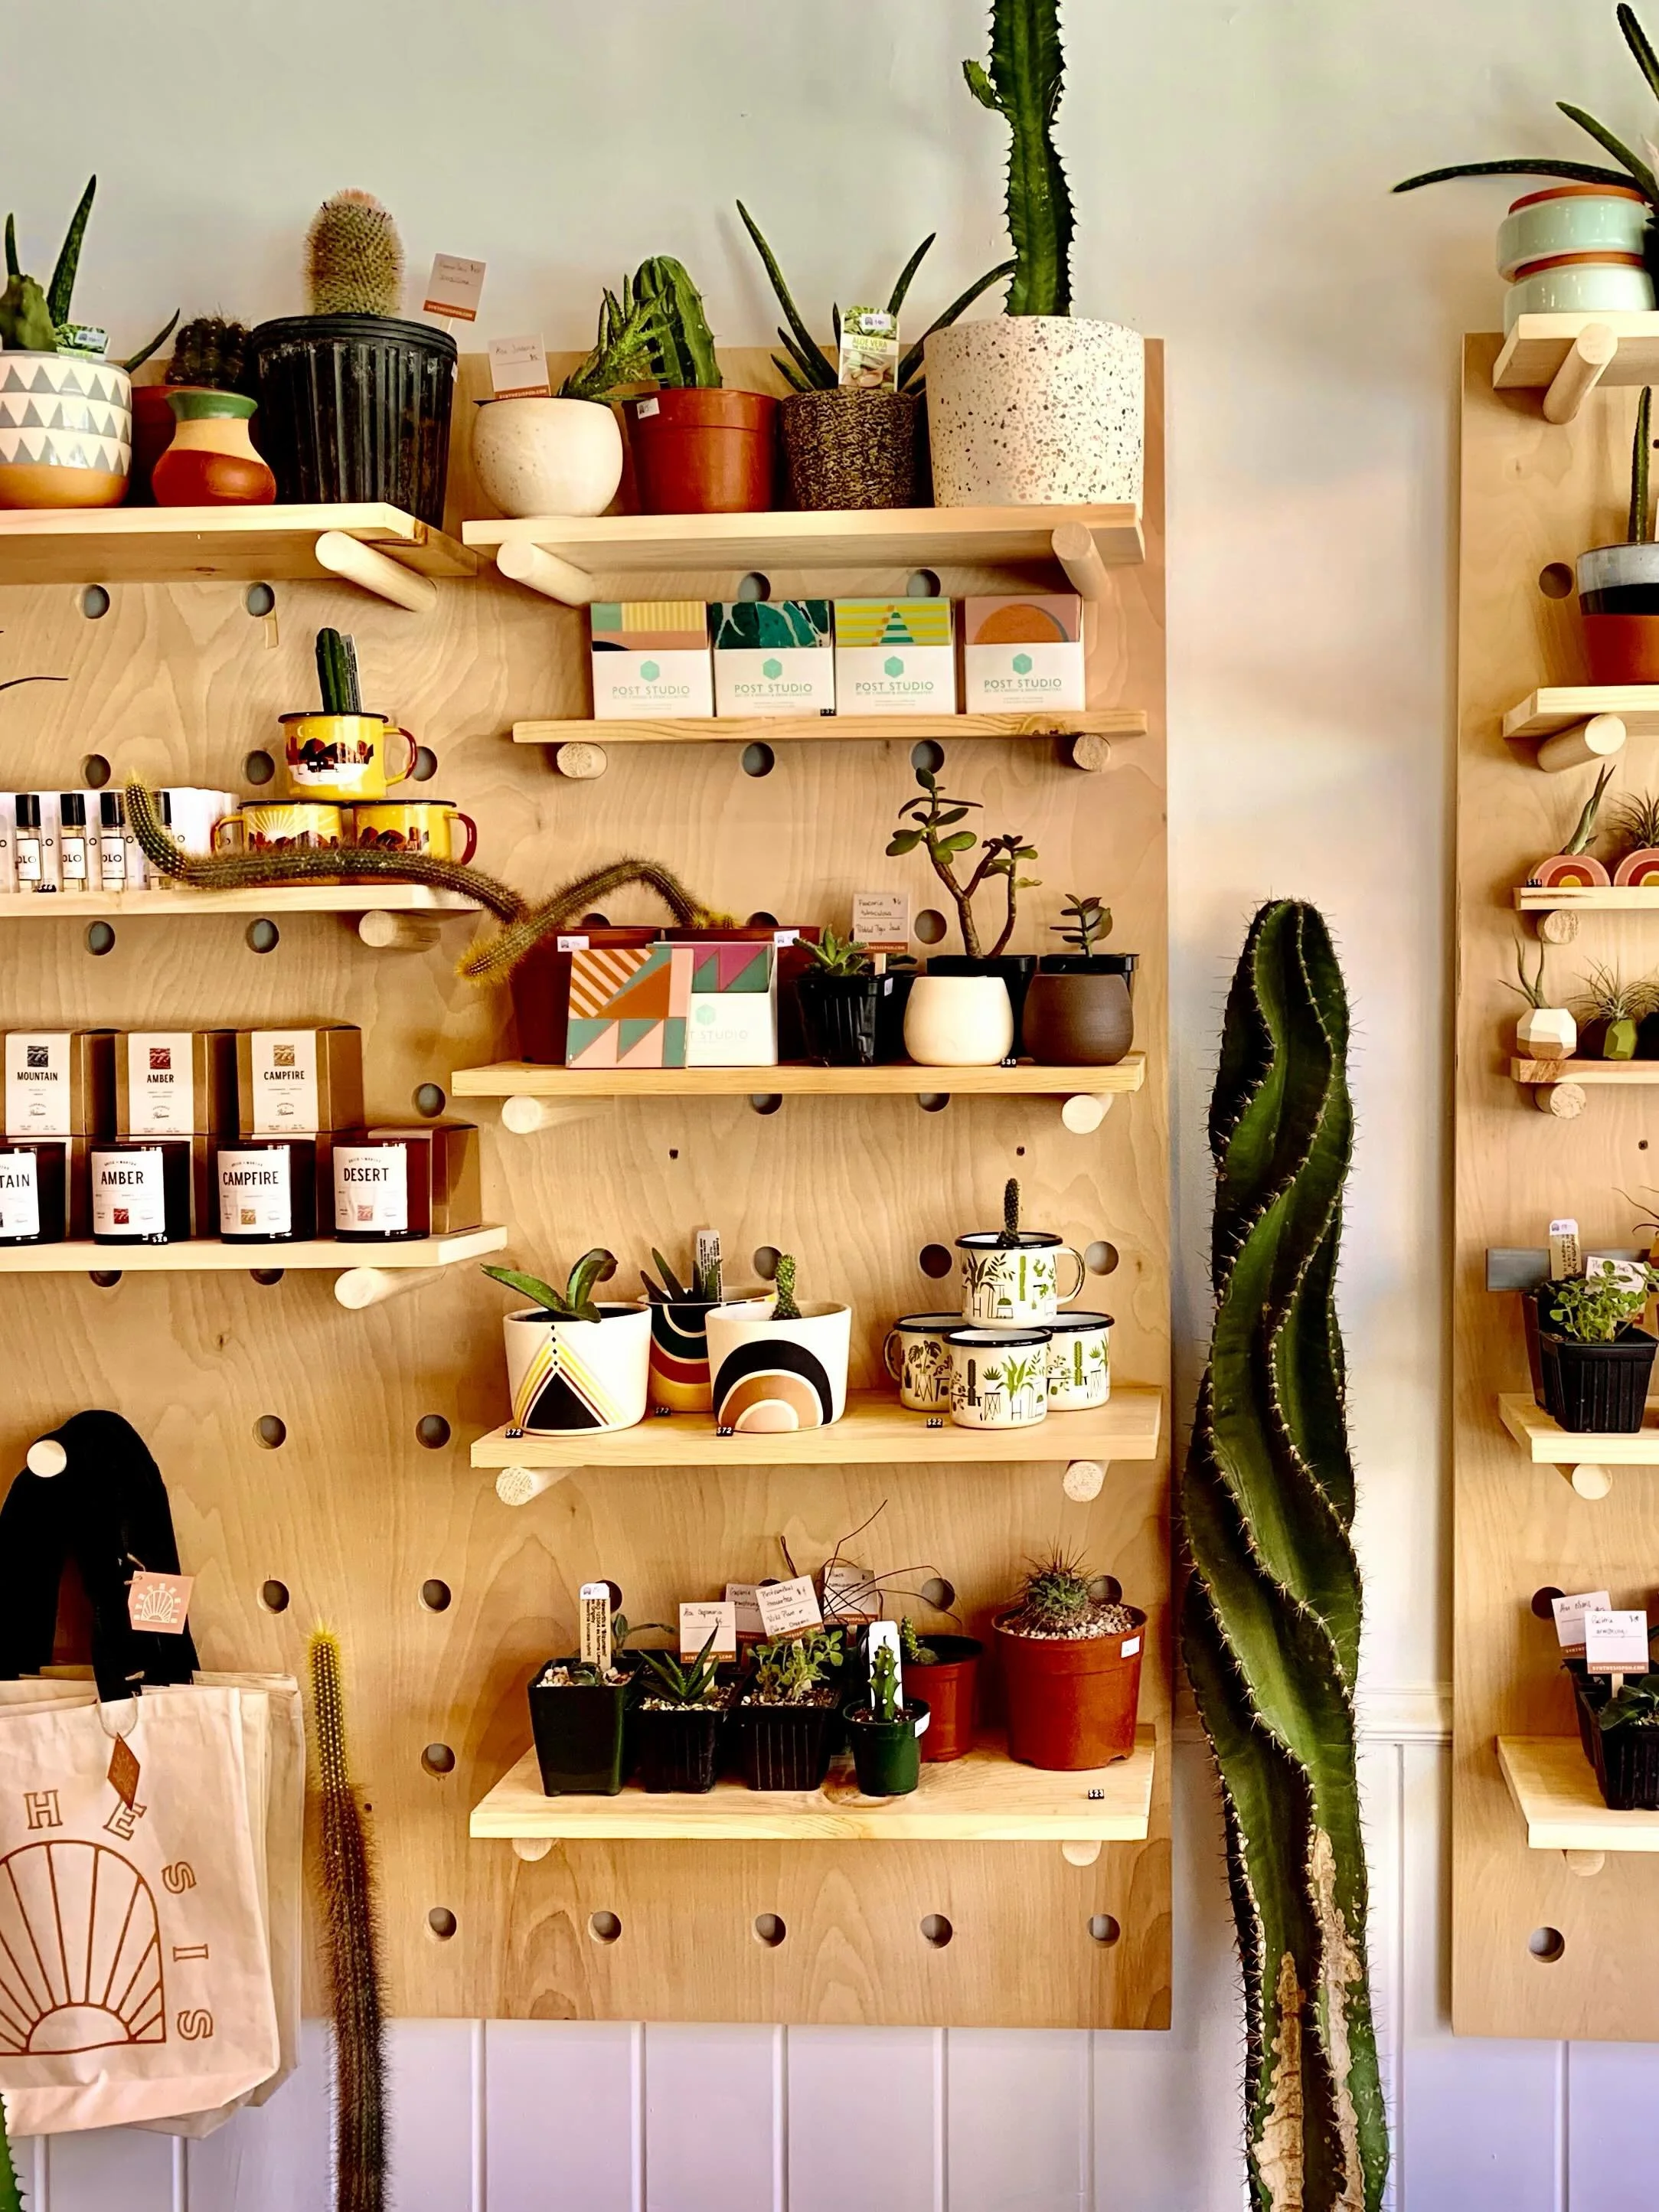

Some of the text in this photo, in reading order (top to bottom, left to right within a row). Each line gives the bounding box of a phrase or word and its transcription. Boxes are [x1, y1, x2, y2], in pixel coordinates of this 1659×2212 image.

[734, 683, 812, 693] POST STUDIO
[856, 681, 934, 691] POST STUDIO
[984, 678, 1062, 688] POST STUDIO
[612, 685, 690, 695] POST STUDIO
[701, 1030, 748, 1040] STUDIO
[17, 1071, 58, 1081] MOUNTAIN
[147, 1073, 175, 1083] AMBER
[263, 1070, 305, 1080] CAMPFIRE
[101, 1171, 144, 1185] AMBER
[223, 1171, 279, 1186] CAMPFIRE
[344, 1167, 390, 1181] DESERT
[506, 1428, 521, 1436] $72
